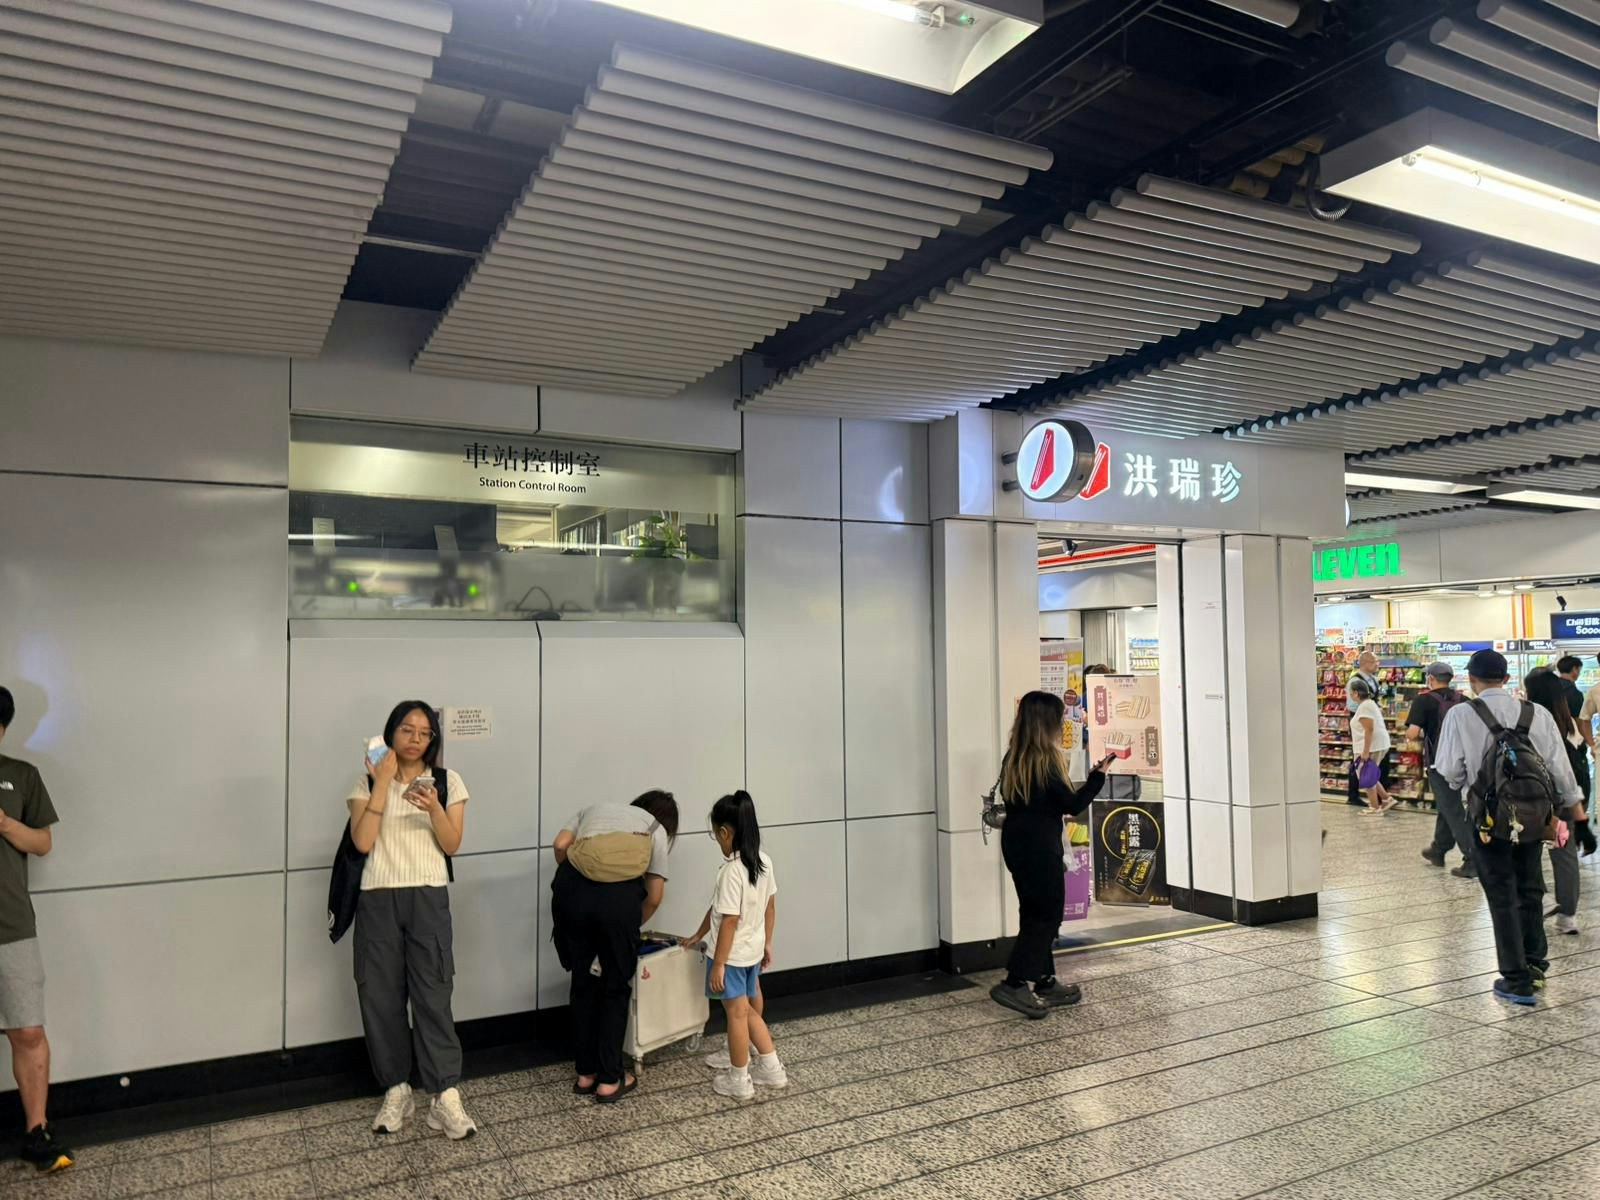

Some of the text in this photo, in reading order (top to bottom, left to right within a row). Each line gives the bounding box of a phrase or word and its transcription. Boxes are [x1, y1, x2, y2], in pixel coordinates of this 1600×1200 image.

[463, 442, 601, 477] 車站控制室
[479, 476, 587, 494] Station Control Room
[1124, 452, 1242, 503] 洪瑞珍
